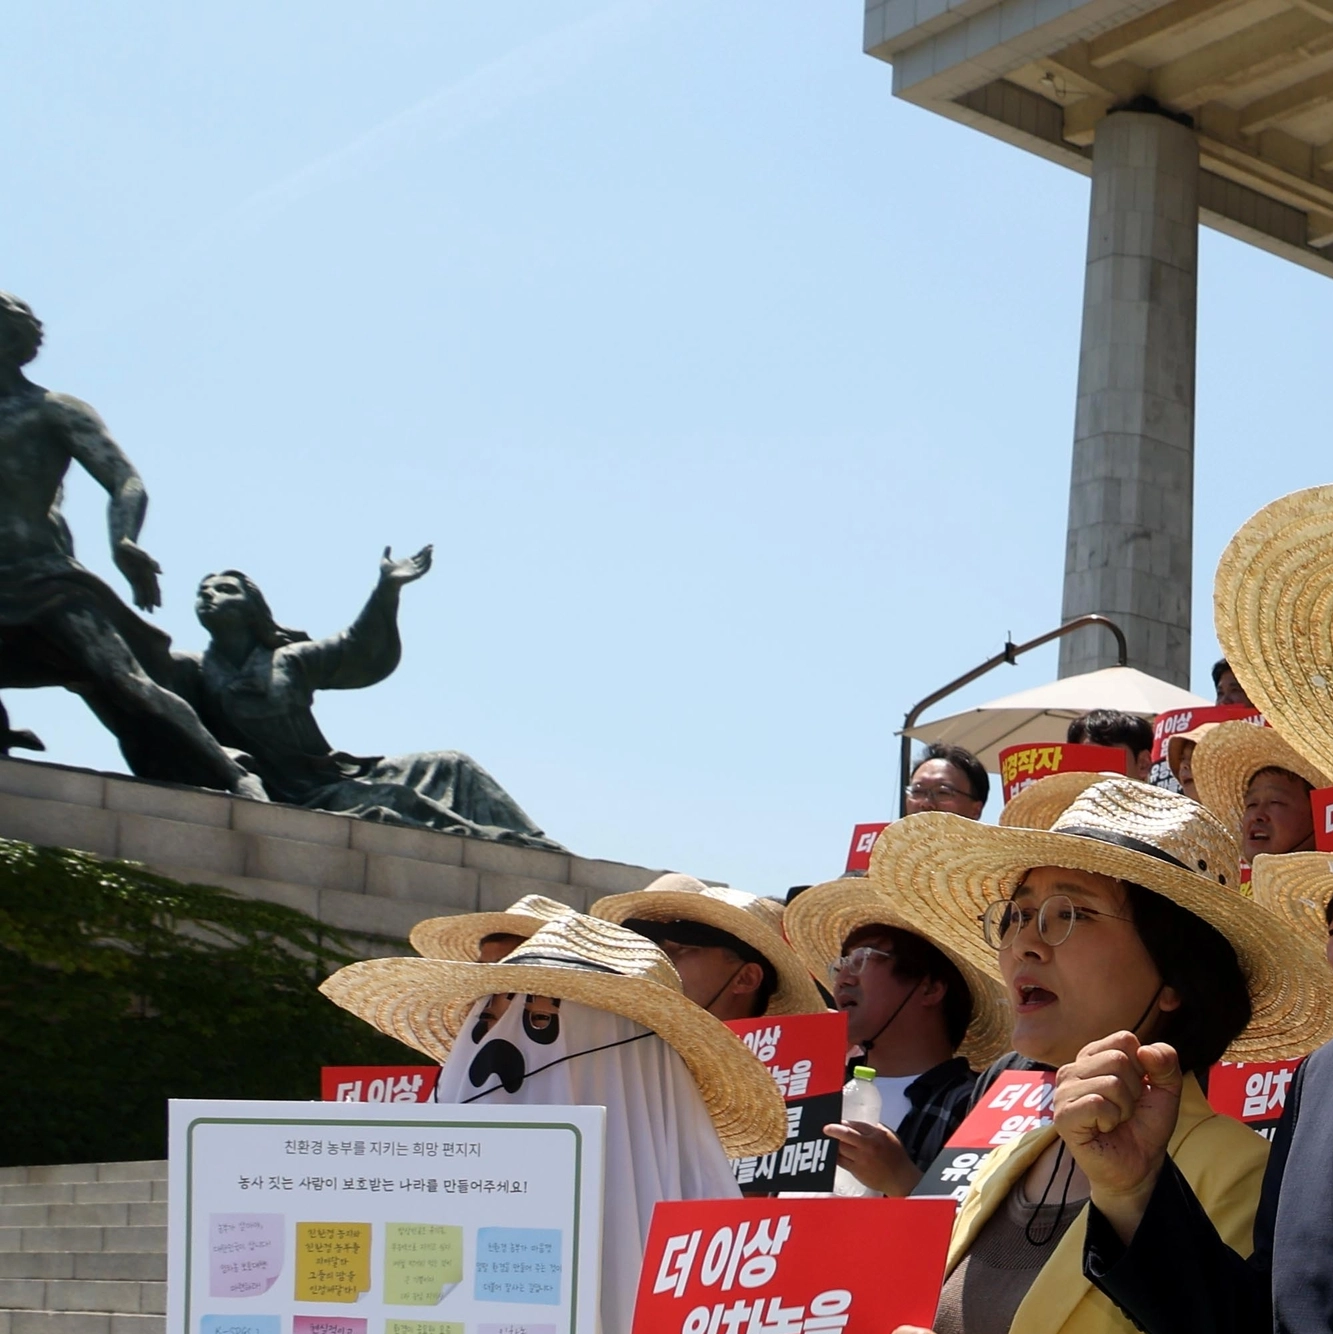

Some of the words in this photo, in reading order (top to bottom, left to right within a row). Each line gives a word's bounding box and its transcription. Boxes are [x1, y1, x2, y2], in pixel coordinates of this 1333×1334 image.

[1165, 712, 1192, 733] 이상
[367, 1075, 423, 1102] 이상
[284, 1140, 324, 1155] 친환경
[327, 1140, 365, 1156] 농부를
[369, 1142, 409, 1157] 지키는
[413, 1142, 439, 1157] 희망
[442, 1142, 481, 1157] 편지지
[779, 1139, 830, 1176] 마라!
[238, 1175, 264, 1189] 농사
[269, 1175, 293, 1191] 짓는
[298, 1177, 337, 1191] 사람이
[343, 1177, 395, 1192] 보호받는
[399, 1178, 439, 1194] 나라를
[443, 1179, 528, 1194] 만들어주세요!
[653, 1231, 692, 1299] 더
[701, 1215, 791, 1291] 이상
